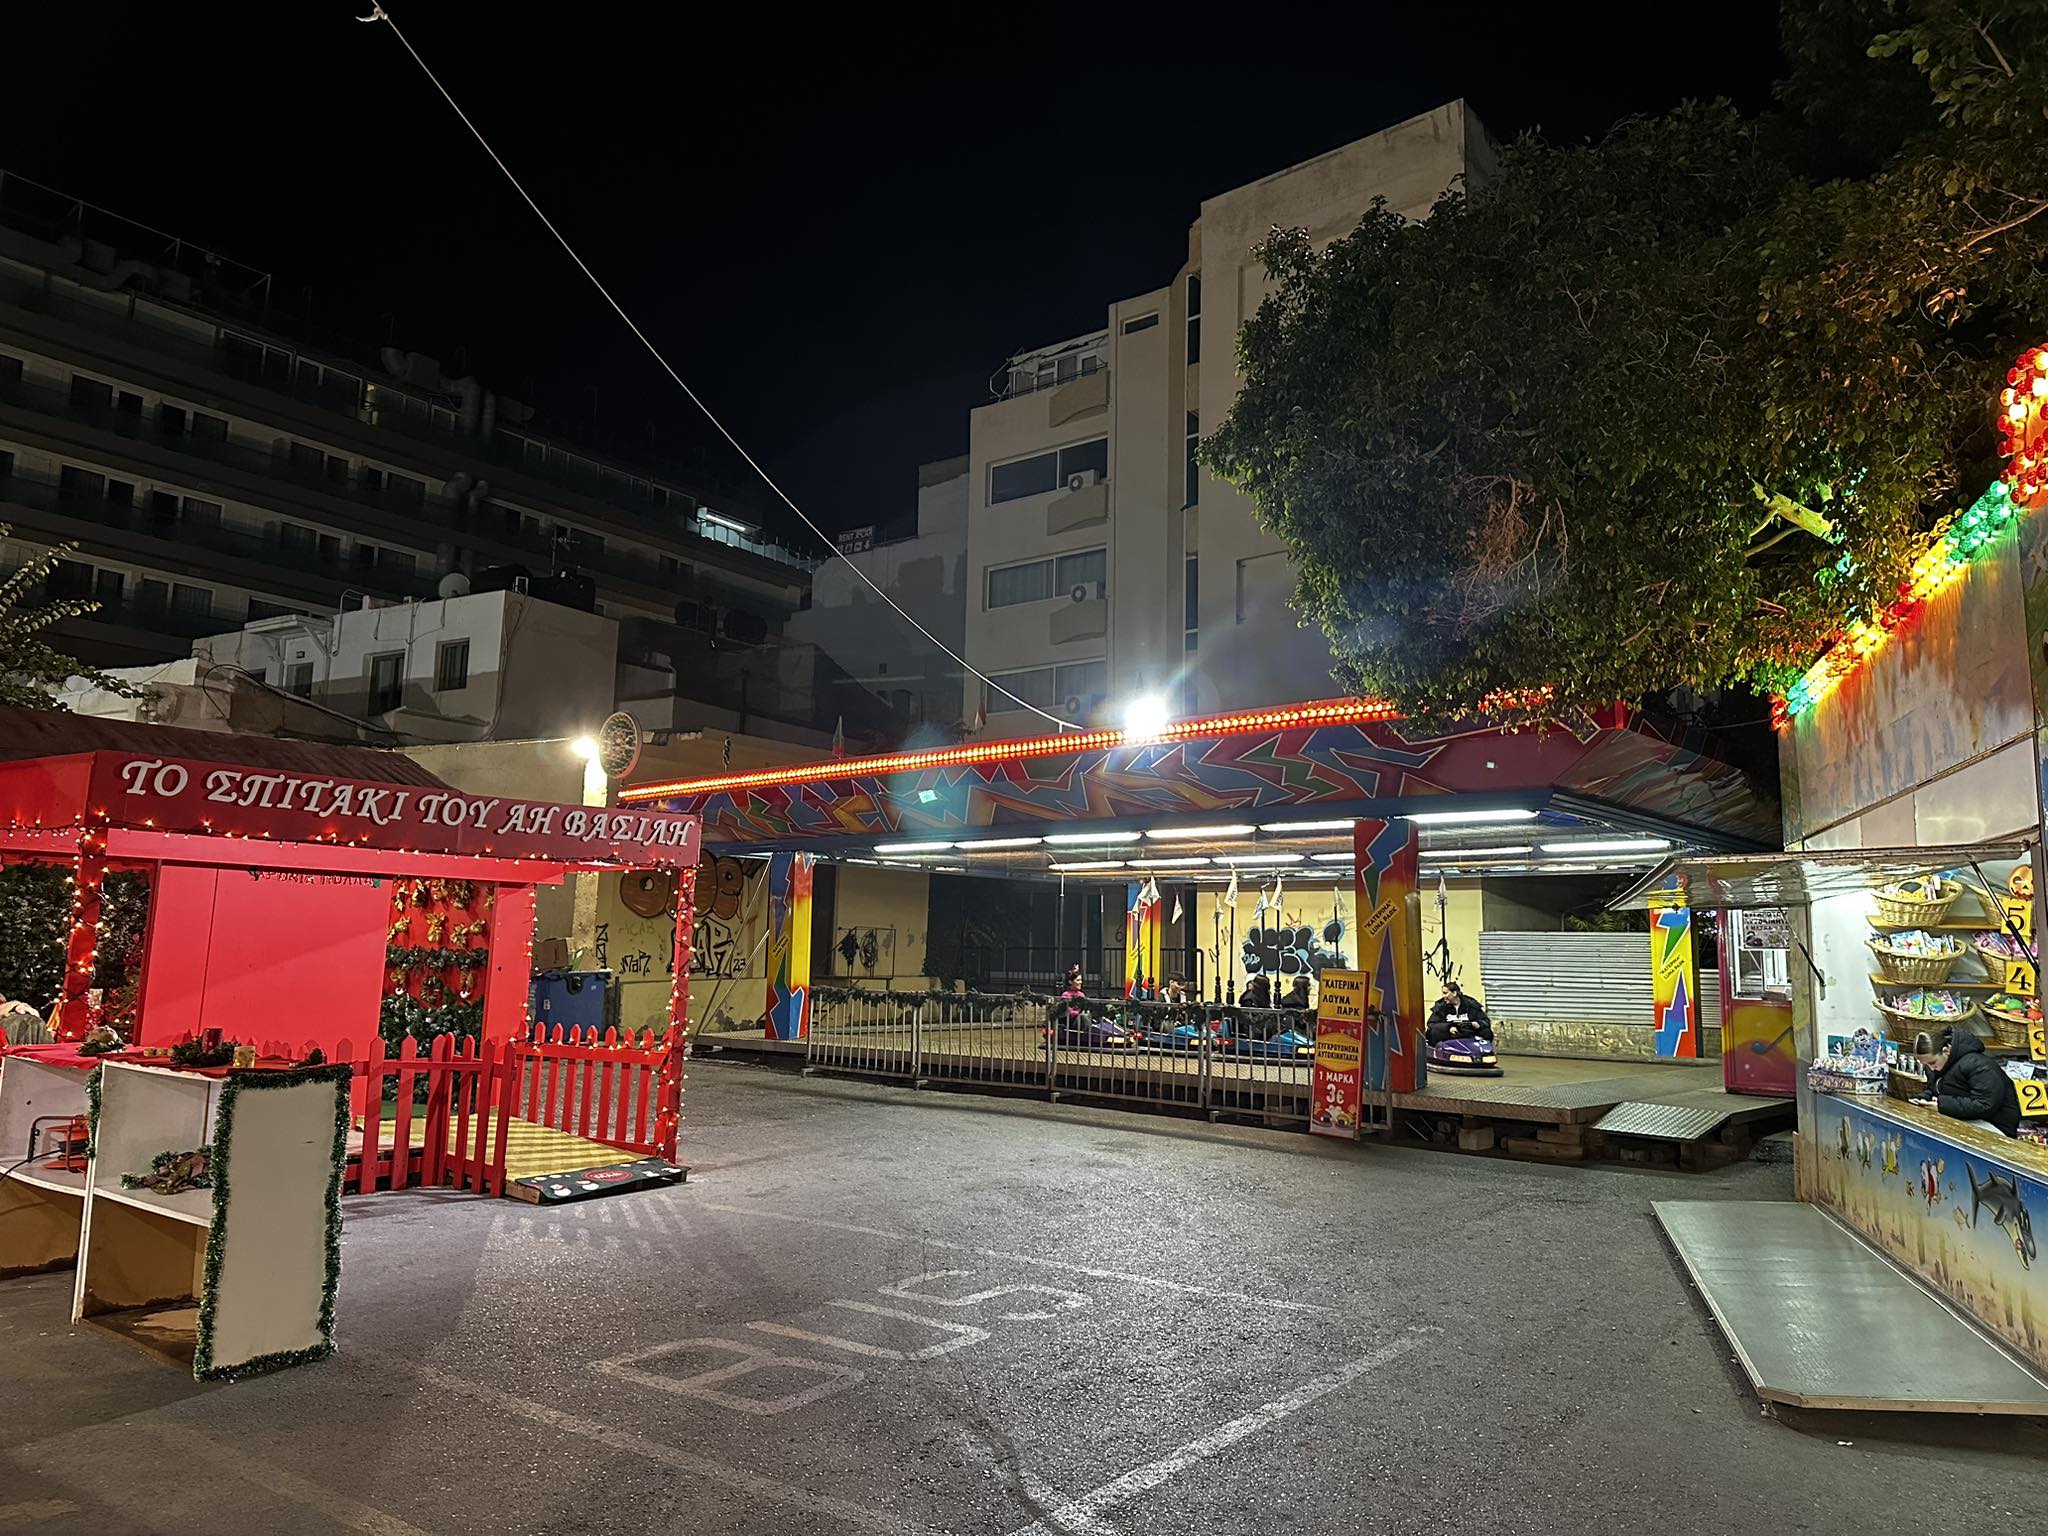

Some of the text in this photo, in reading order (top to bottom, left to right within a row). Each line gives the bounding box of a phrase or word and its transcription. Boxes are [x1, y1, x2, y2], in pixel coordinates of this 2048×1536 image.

[121, 759, 695, 847] ΤΟ ΣΠΙΤΑΚΙ ΤΟΥ ΑΗ ΒΑΣΙΛΗ
[2007, 905, 2025, 931] 5
[2009, 966, 2032, 992] 4
[1322, 994, 1351, 1005] ΛΟΥΝΑ
[1336, 1005, 1360, 1017] ΠΑΡΚ
[2034, 1030, 2046, 1057] 3
[1319, 1070, 1354, 1085] 1 ΜΑΡΚΑ
[1326, 1082, 1345, 1105] 3€
[2021, 1084, 2048, 1111] 2
[586, 1269, 1092, 1416] BUS
